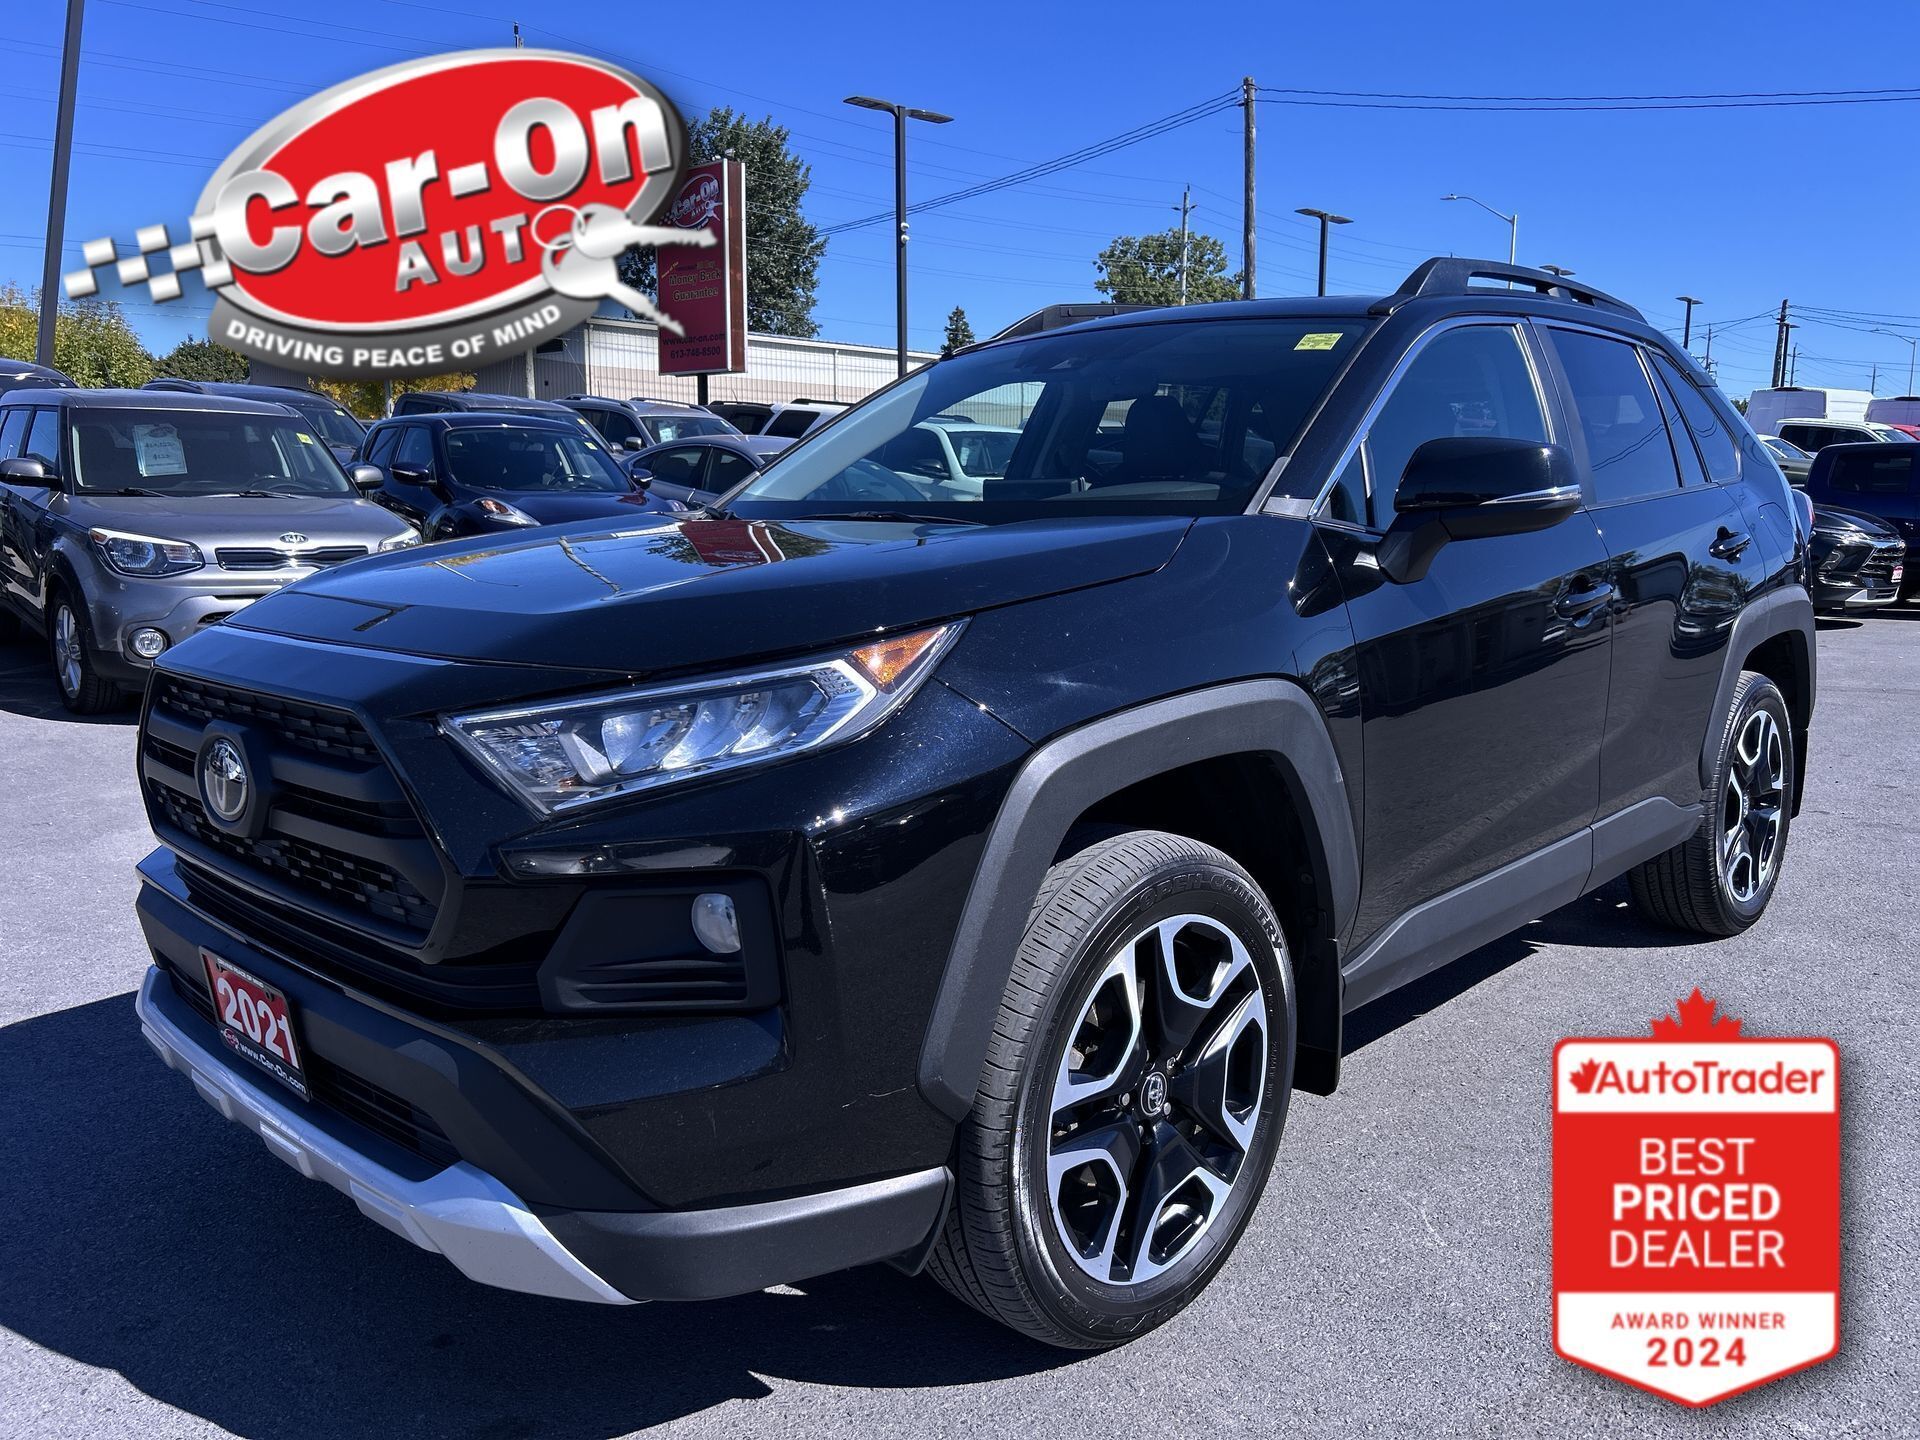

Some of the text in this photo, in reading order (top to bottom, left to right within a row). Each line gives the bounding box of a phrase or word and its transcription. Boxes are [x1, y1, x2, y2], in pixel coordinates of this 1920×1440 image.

[671, 179, 719, 219] Car-On
[669, 268, 721, 286] Money Back
[673, 287, 719, 301] Guarantee
[217, 977, 300, 1069] 2021
[240, 1042, 307, 1094] www.Car-On.com
